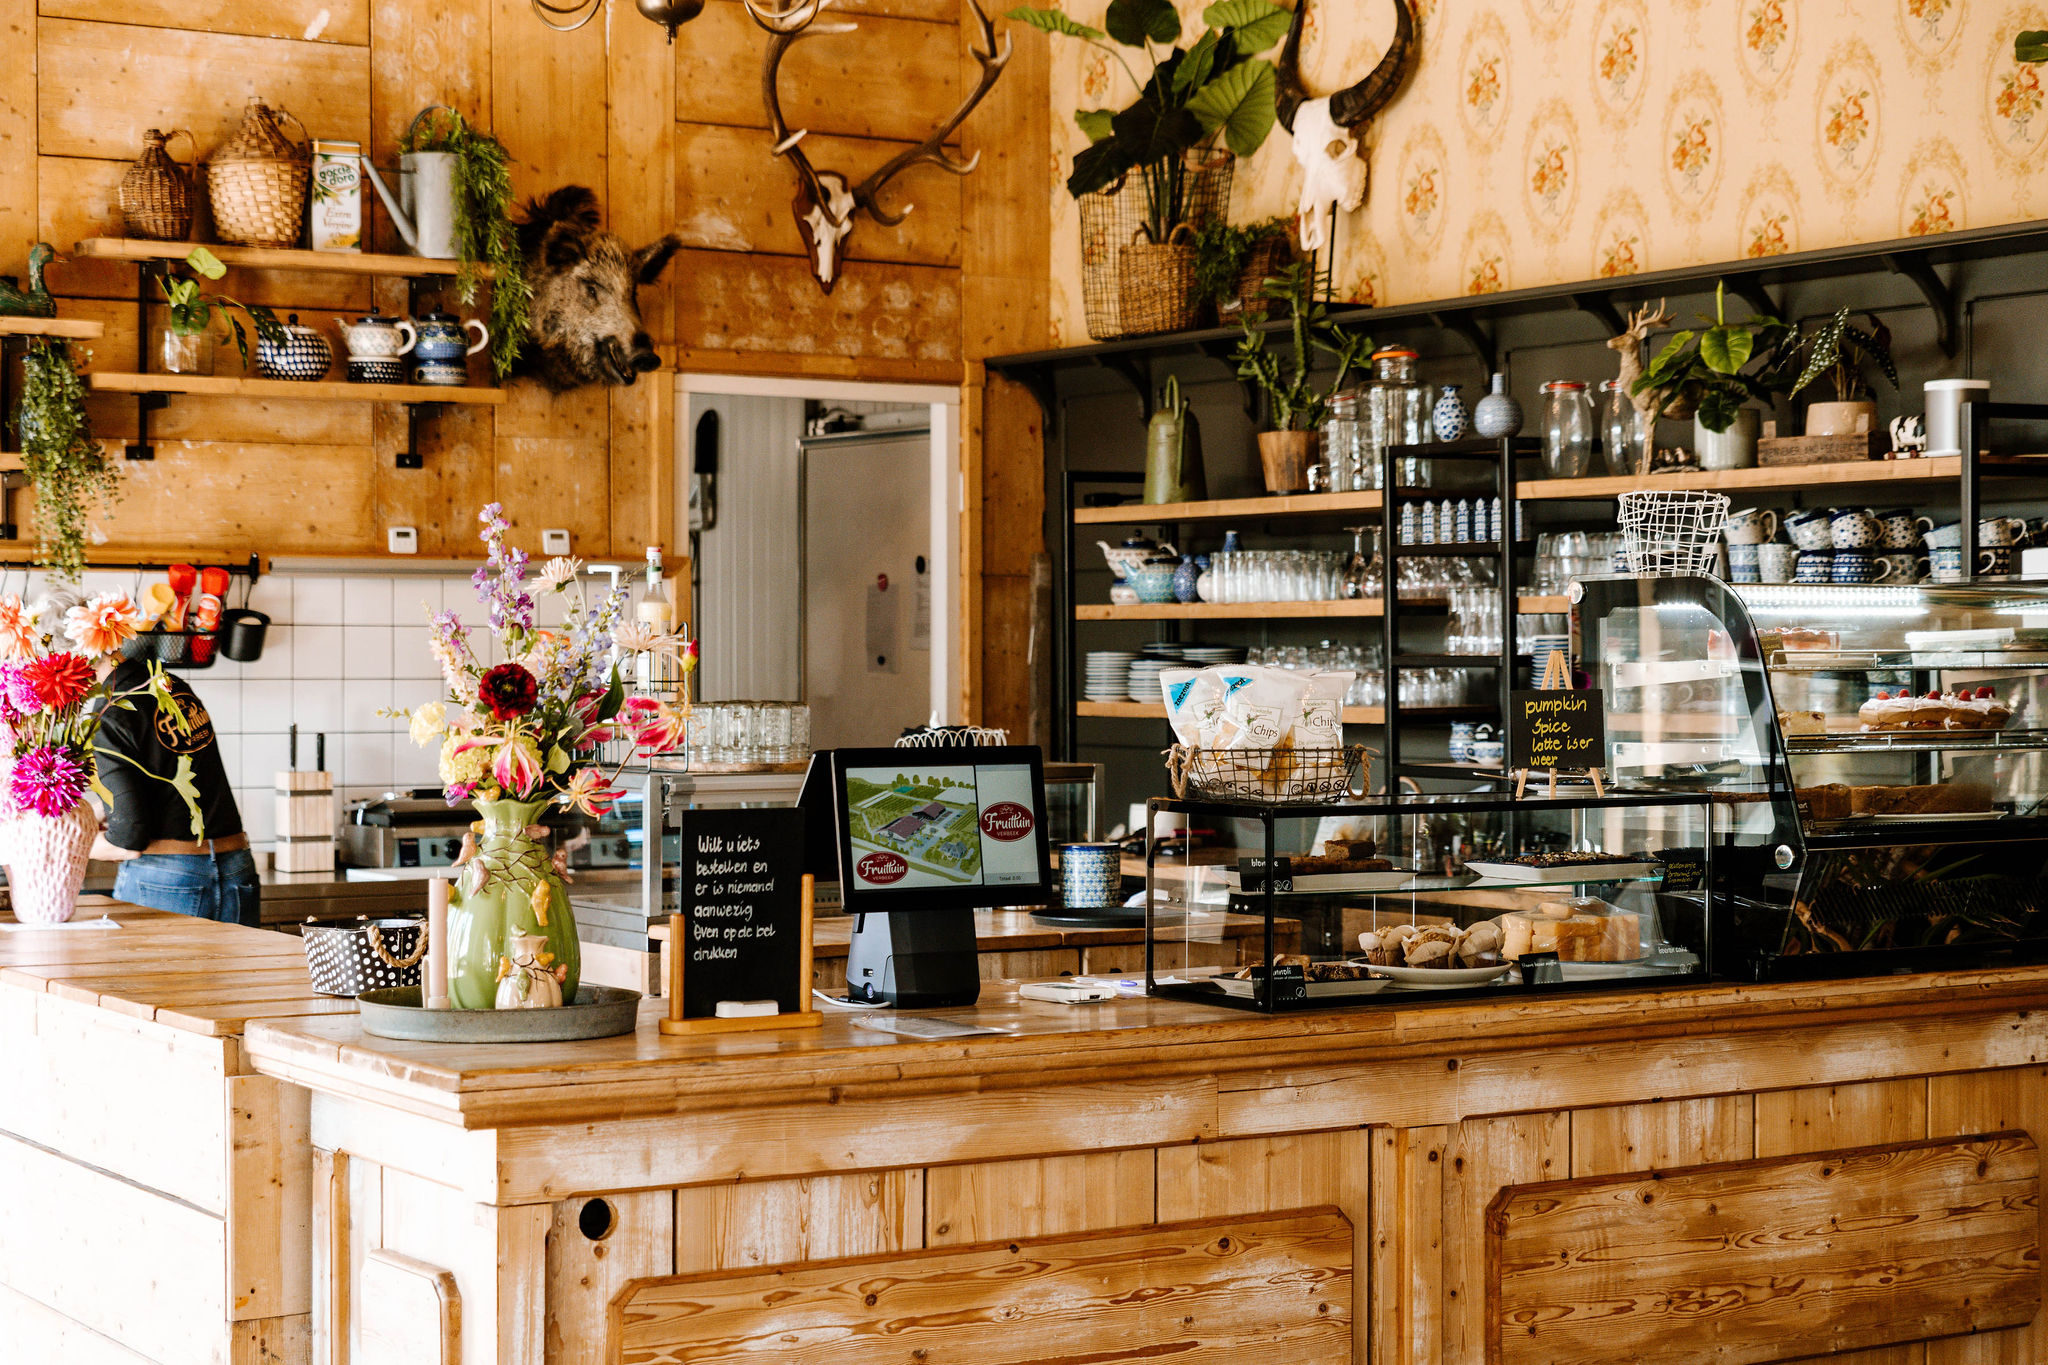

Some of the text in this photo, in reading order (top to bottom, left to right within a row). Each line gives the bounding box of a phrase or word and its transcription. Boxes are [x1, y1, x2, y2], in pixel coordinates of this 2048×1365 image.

[1525, 694, 1587, 719] pumpkin
[1253, 724, 1279, 739] Chips
[1532, 735, 1594, 753] latte is er
[1530, 755, 1558, 767] weer
[984, 811, 1031, 832] Fruittuin
[698, 834, 761, 853] Wilt u iets
[696, 858, 768, 877] bestellen en
[860, 859, 905, 877] Fruittuin
[695, 877, 775, 897] er is niemand
[694, 900, 754, 922] aanwezig
[723, 928, 737, 942] op
[693, 946, 738, 961] drukken
